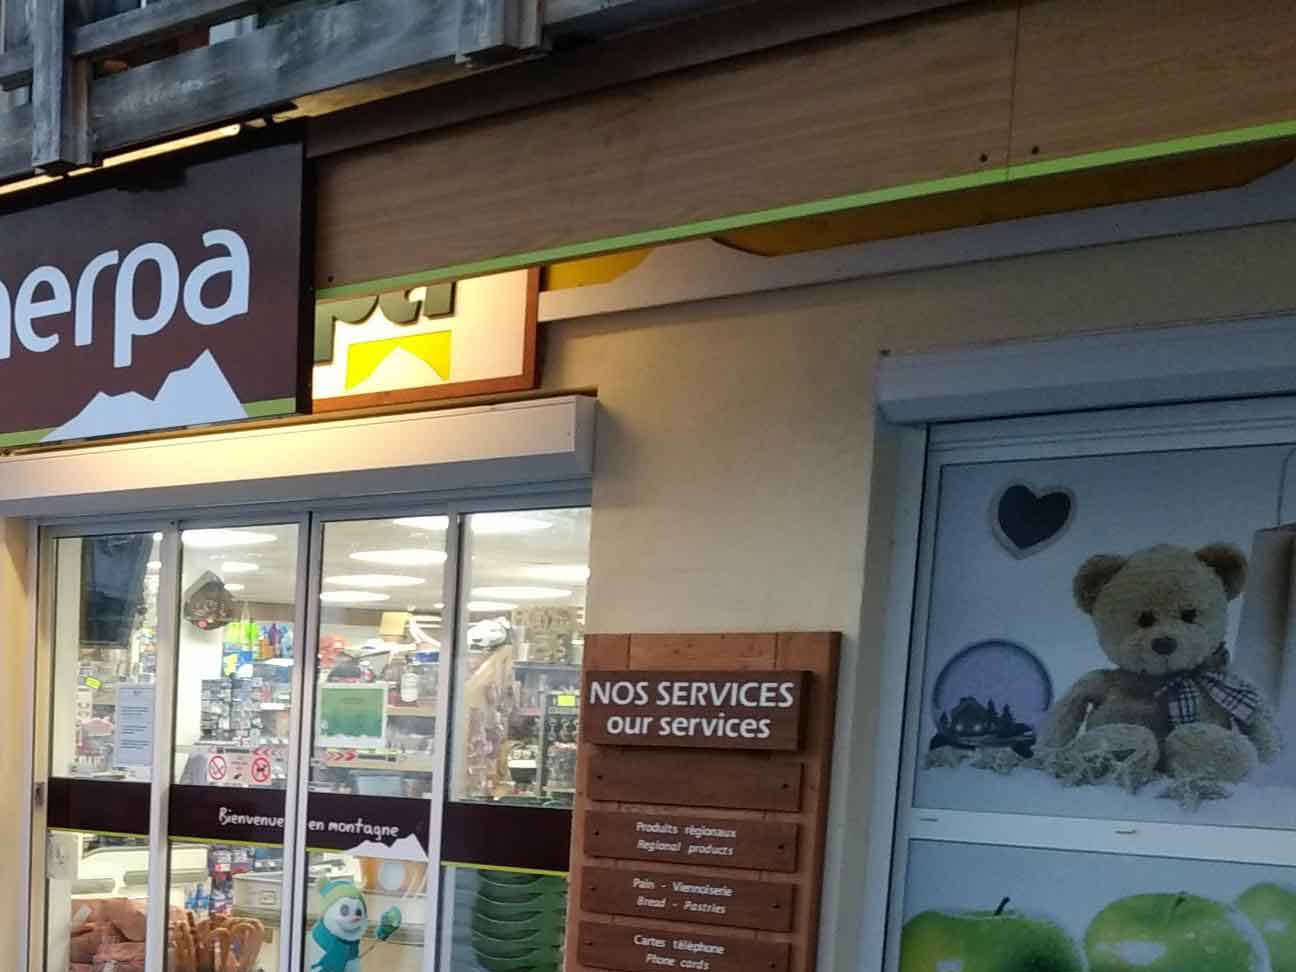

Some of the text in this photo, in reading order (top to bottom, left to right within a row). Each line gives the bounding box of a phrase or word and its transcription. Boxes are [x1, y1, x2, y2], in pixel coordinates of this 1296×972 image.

[589, 681, 794, 708] NOS SERVICES
[607, 712, 771, 738] our services
[218, 807, 400, 841] Bienvenue en montagne
[636, 822, 736, 838] Produits régionaux
[637, 839, 733, 856] Regional products
[632, 878, 655, 889] Pain
[637, 896, 667, 908] Bread
[683, 902, 726, 914] Pastries
[634, 934, 666, 948] Cartes
[645, 954, 710, 970] Phone cards
